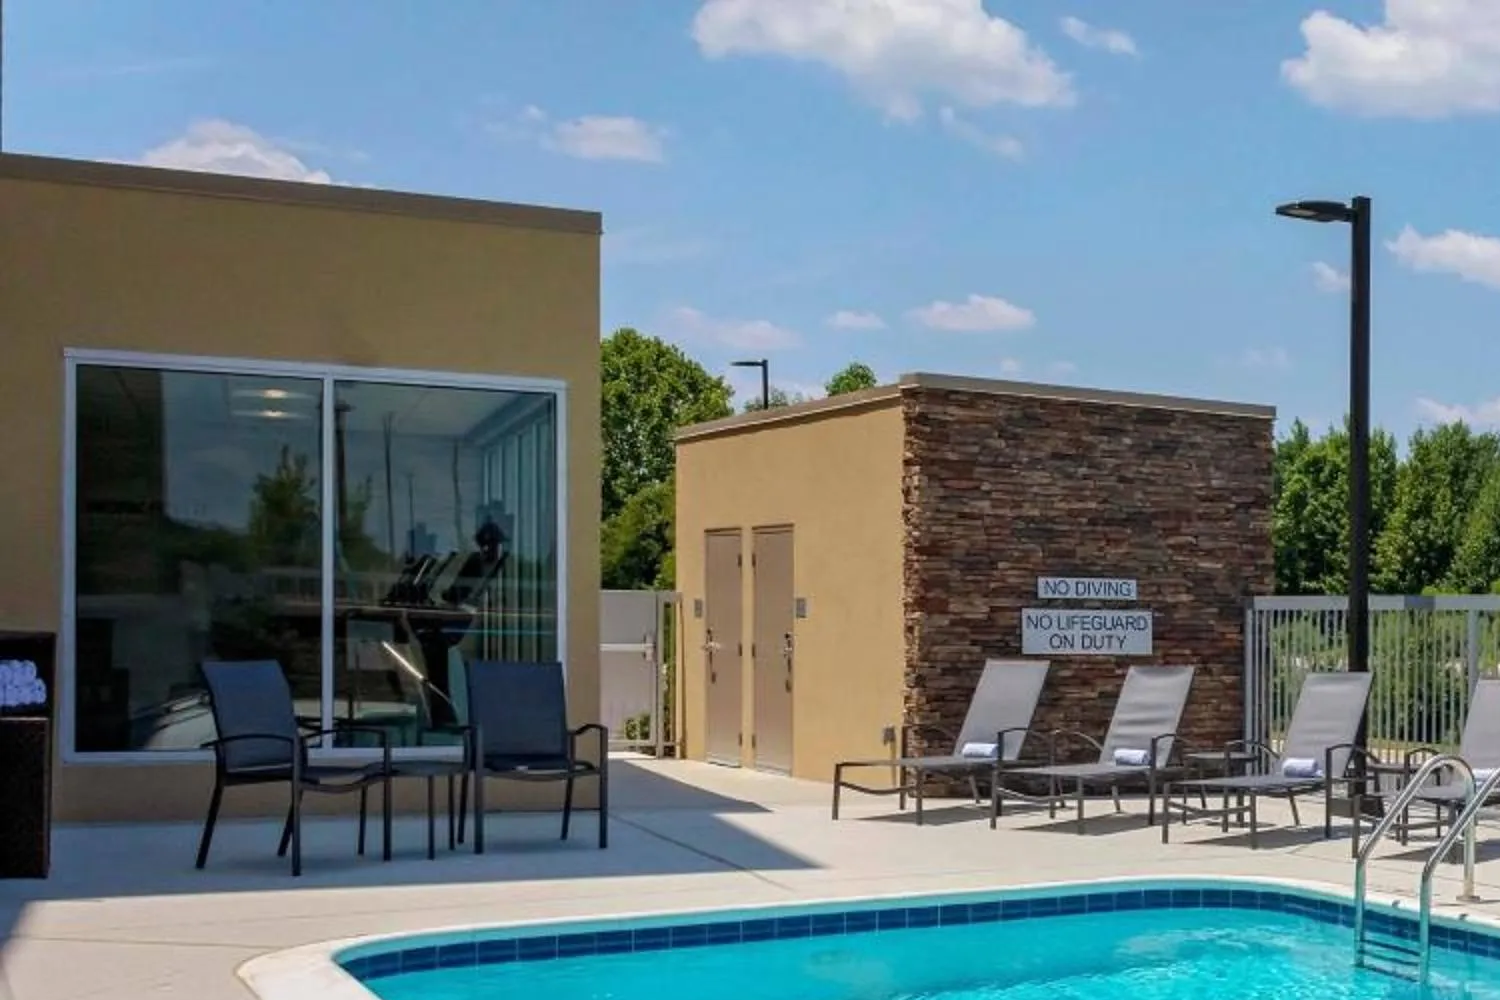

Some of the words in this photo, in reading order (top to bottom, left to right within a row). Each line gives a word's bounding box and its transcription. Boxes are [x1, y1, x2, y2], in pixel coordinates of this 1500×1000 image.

[1043, 579, 1070, 596] NO
[1075, 580, 1132, 597] DIVING
[1026, 615, 1052, 631] NO
[1058, 615, 1148, 631] LIFEGUARD
[1049, 633, 1074, 649] ON
[1081, 634, 1127, 650] DUTY
